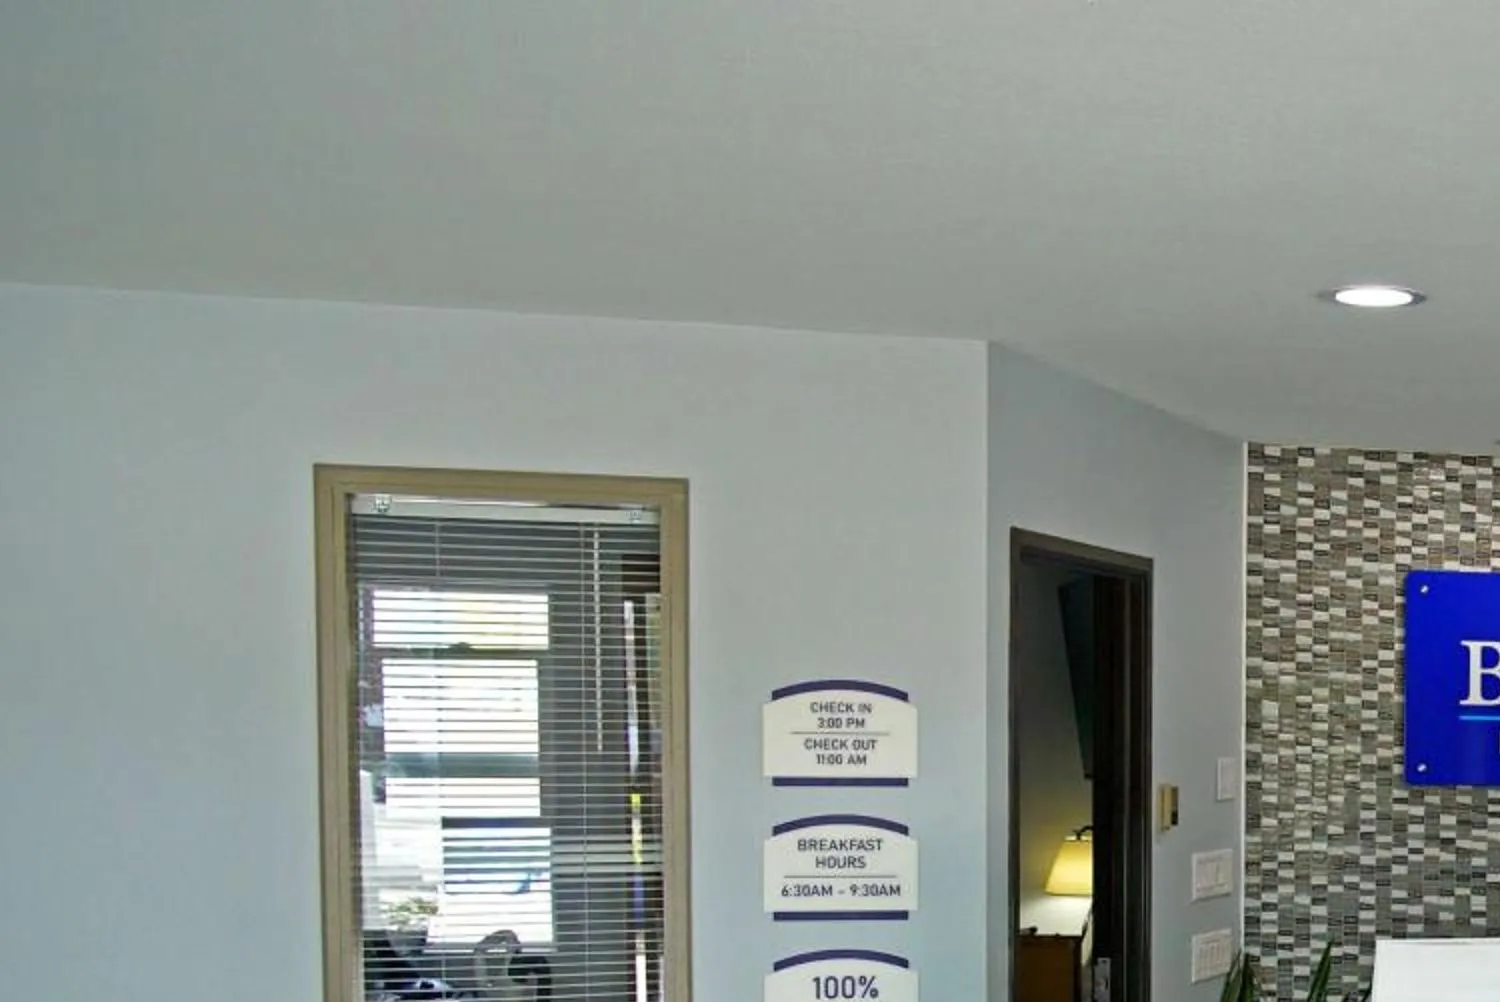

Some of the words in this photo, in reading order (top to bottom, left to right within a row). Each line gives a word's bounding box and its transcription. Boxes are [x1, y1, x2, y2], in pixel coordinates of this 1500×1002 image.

[810, 701, 855, 713] CHECK
[858, 703, 872, 713] IN
[817, 717, 842, 729] 3:00
[846, 717, 865, 729] PM
[804, 738, 848, 750] CHECK
[852, 740, 877, 750] OUT
[816, 754, 842, 765] 11:00
[846, 754, 867, 765] AM
[797, 838, 884, 851] BREAKFAST
[815, 856, 867, 869] HOURS
[781, 884, 833, 897] 6:30AM
[849, 884, 901, 897] 9:30AM
[812, 975, 879, 1000] 100%
